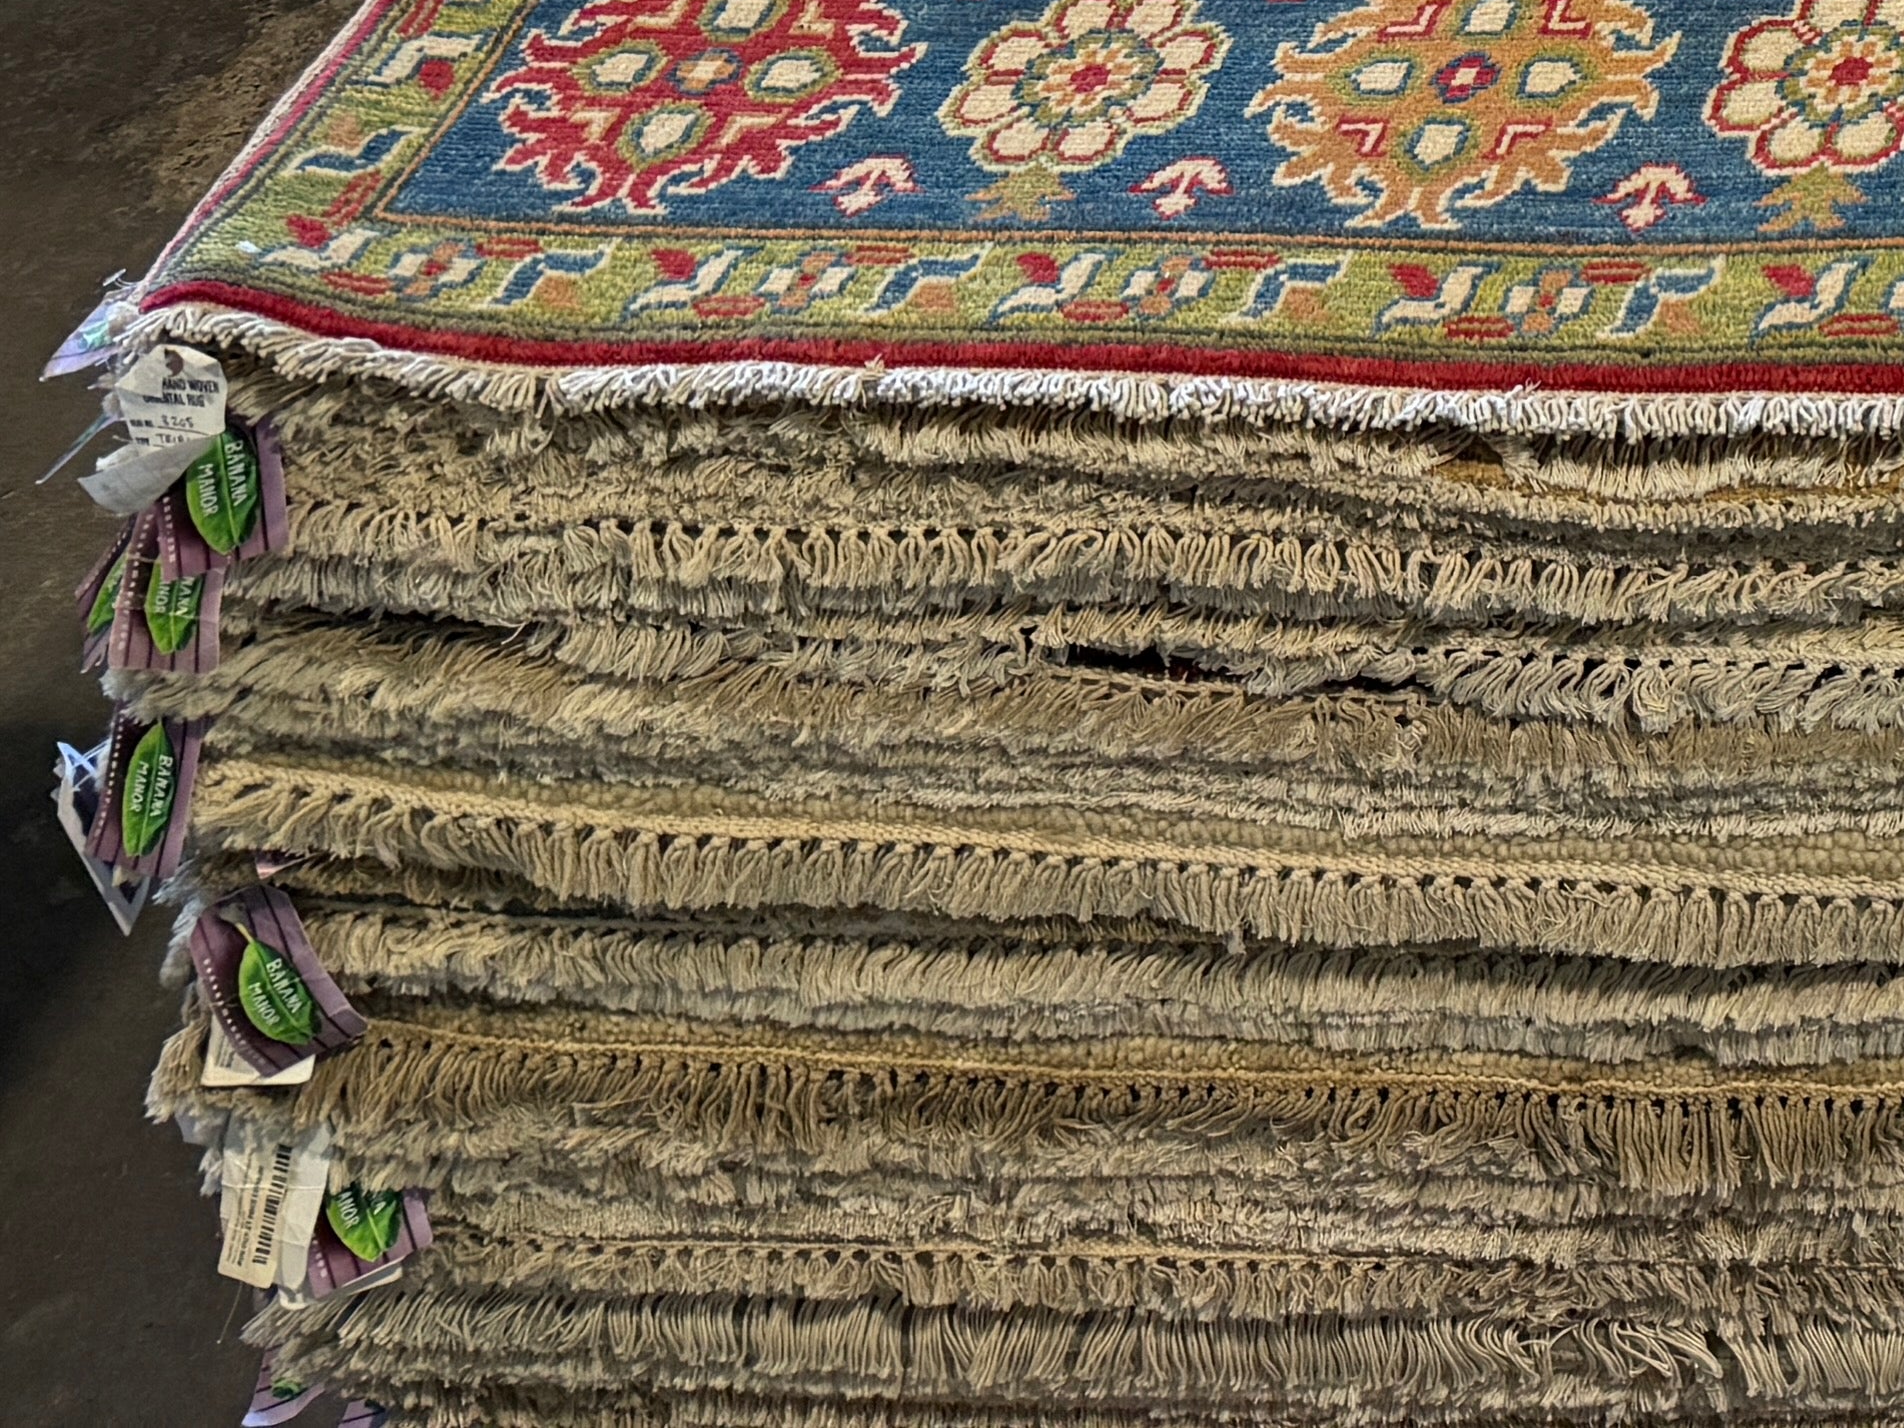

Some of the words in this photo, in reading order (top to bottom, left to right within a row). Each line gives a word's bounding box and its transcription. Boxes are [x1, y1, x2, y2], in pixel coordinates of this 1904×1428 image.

[187, 379, 220, 394] WOVEN
[197, 463, 220, 517] MANOR
[224, 439, 248, 506] BANANA
[130, 760, 150, 813] MANOR
[149, 754, 174, 817] BANANA
[247, 982, 281, 1026] MANOR
[266, 957, 304, 1014] BANANA
